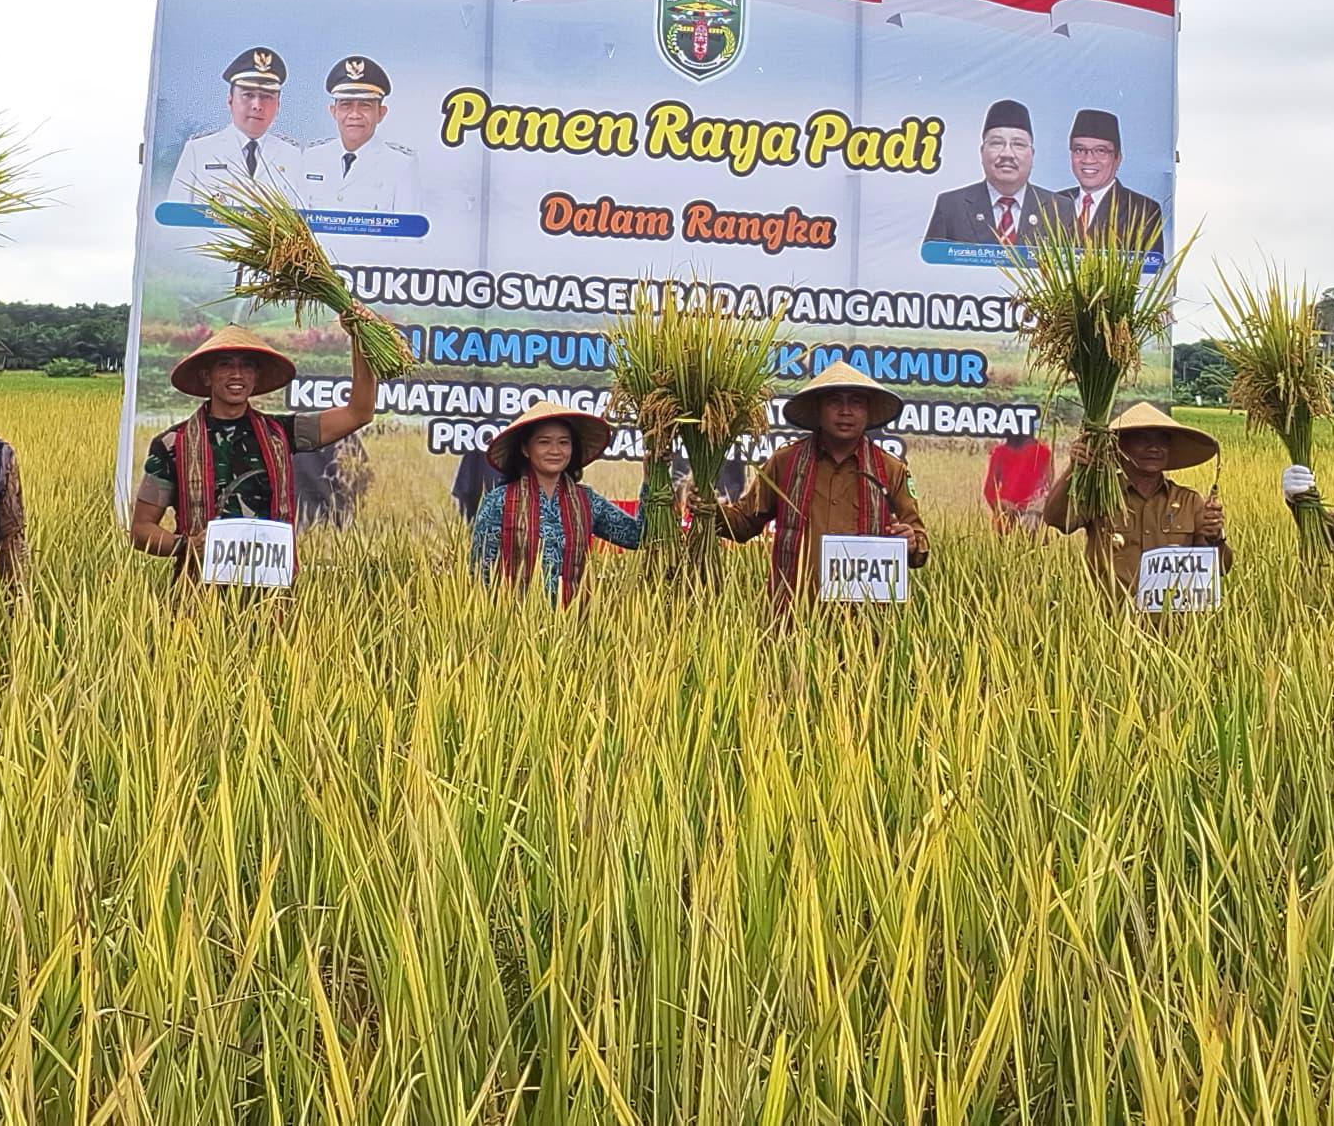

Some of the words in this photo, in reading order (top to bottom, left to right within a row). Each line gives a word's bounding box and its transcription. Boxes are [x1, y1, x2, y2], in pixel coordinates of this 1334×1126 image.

[445, 91, 636, 153] Panen
[647, 104, 797, 172] Raya
[807, 113, 944, 170] Padi
[543, 195, 671, 236] Dalam
[685, 203, 832, 251] Rangka
[772, 289, 921, 324] PANGAN
[290, 379, 494, 415] KECMATAN
[935, 404, 1037, 435] BARAT
[212, 539, 287, 569] DANDIM
[829, 558, 900, 583] BUPATI
[1147, 555, 1208, 574] WAKIL
